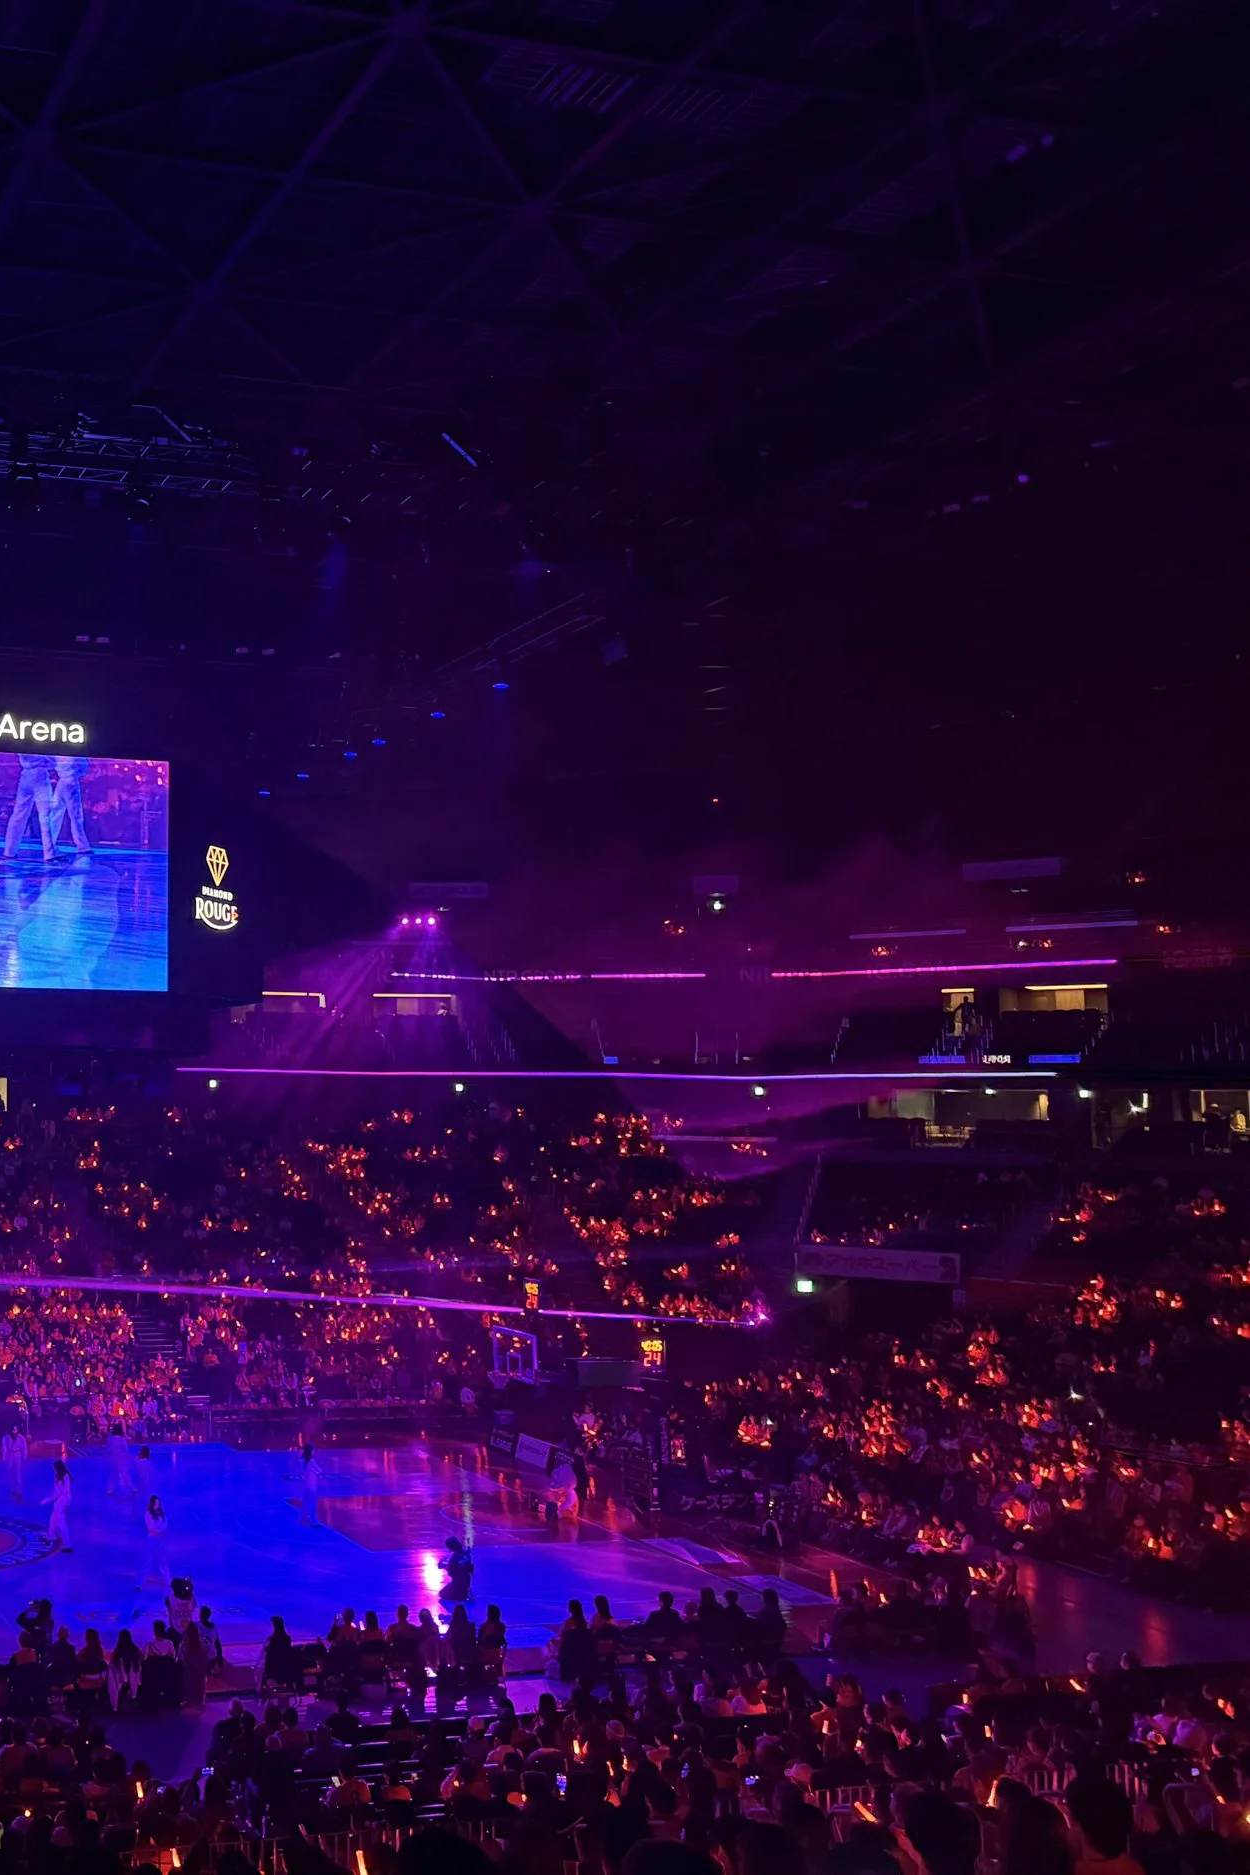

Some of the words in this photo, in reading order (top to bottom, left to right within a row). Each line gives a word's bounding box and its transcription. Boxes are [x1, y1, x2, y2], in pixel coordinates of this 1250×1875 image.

[202, 885, 233, 901] DIAMOND
[195, 897, 239, 927] ROUGE
[643, 1352, 661, 1367] 24
